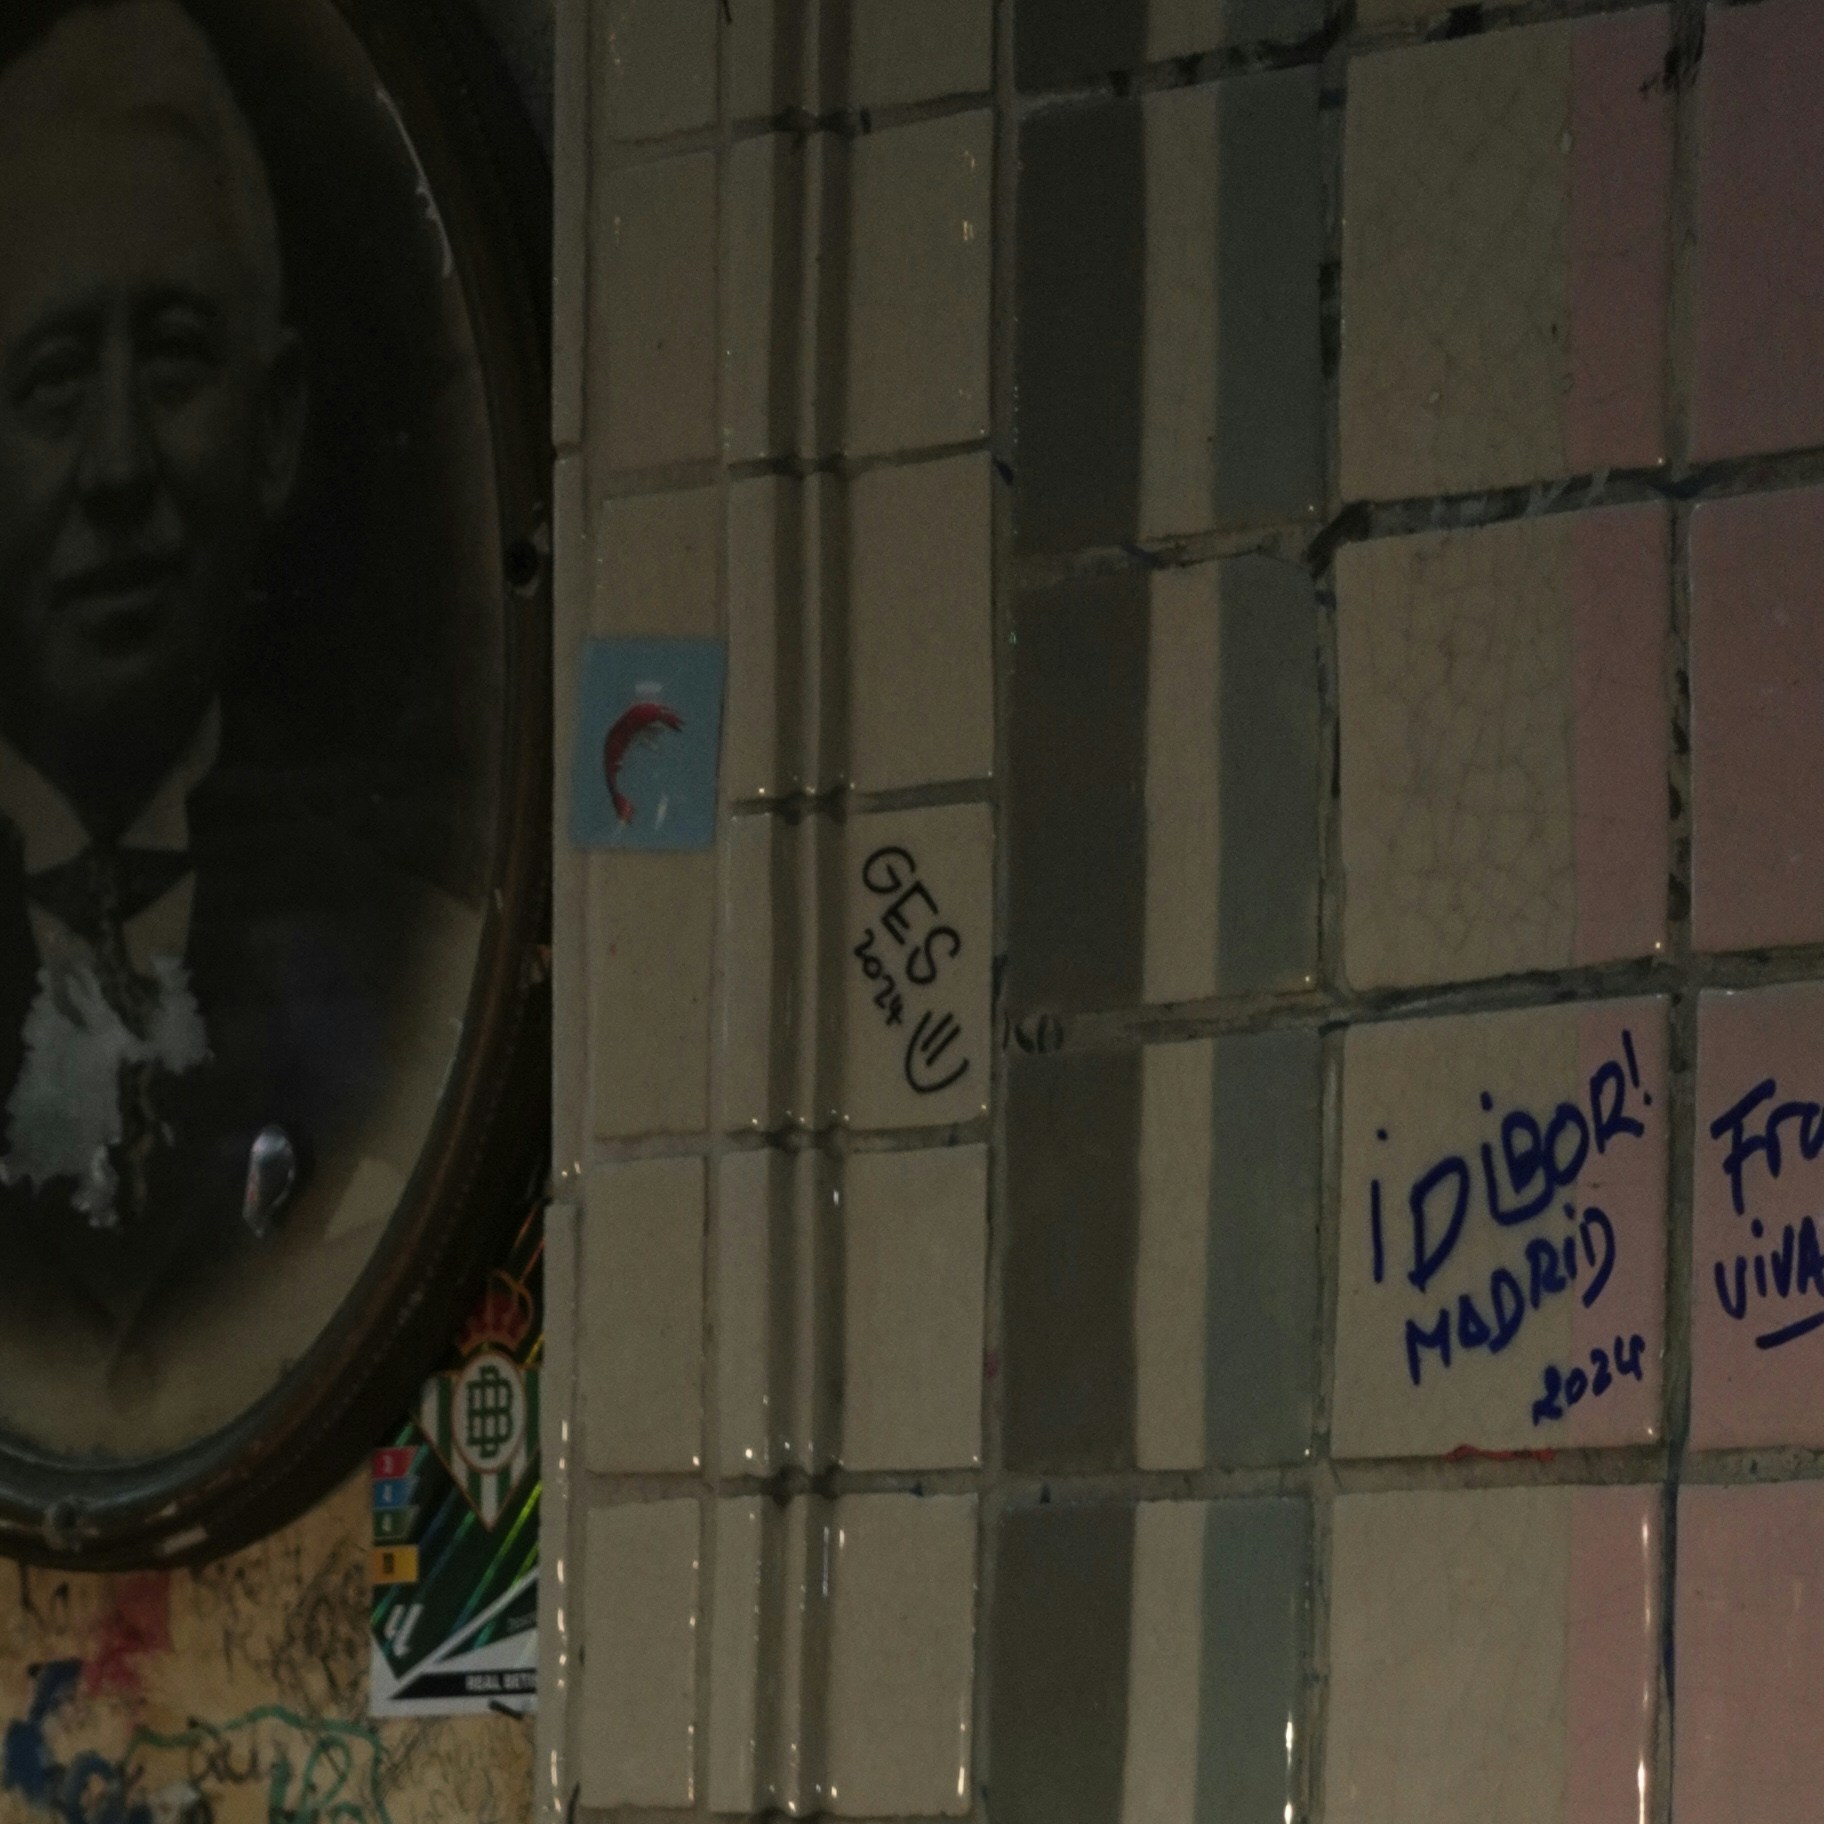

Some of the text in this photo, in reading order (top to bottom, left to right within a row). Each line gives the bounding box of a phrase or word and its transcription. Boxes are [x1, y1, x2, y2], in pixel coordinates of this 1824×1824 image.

[863, 847, 960, 984] GES
[854, 928, 902, 1025] 2024
[1532, 1335, 1645, 1426] 2024
